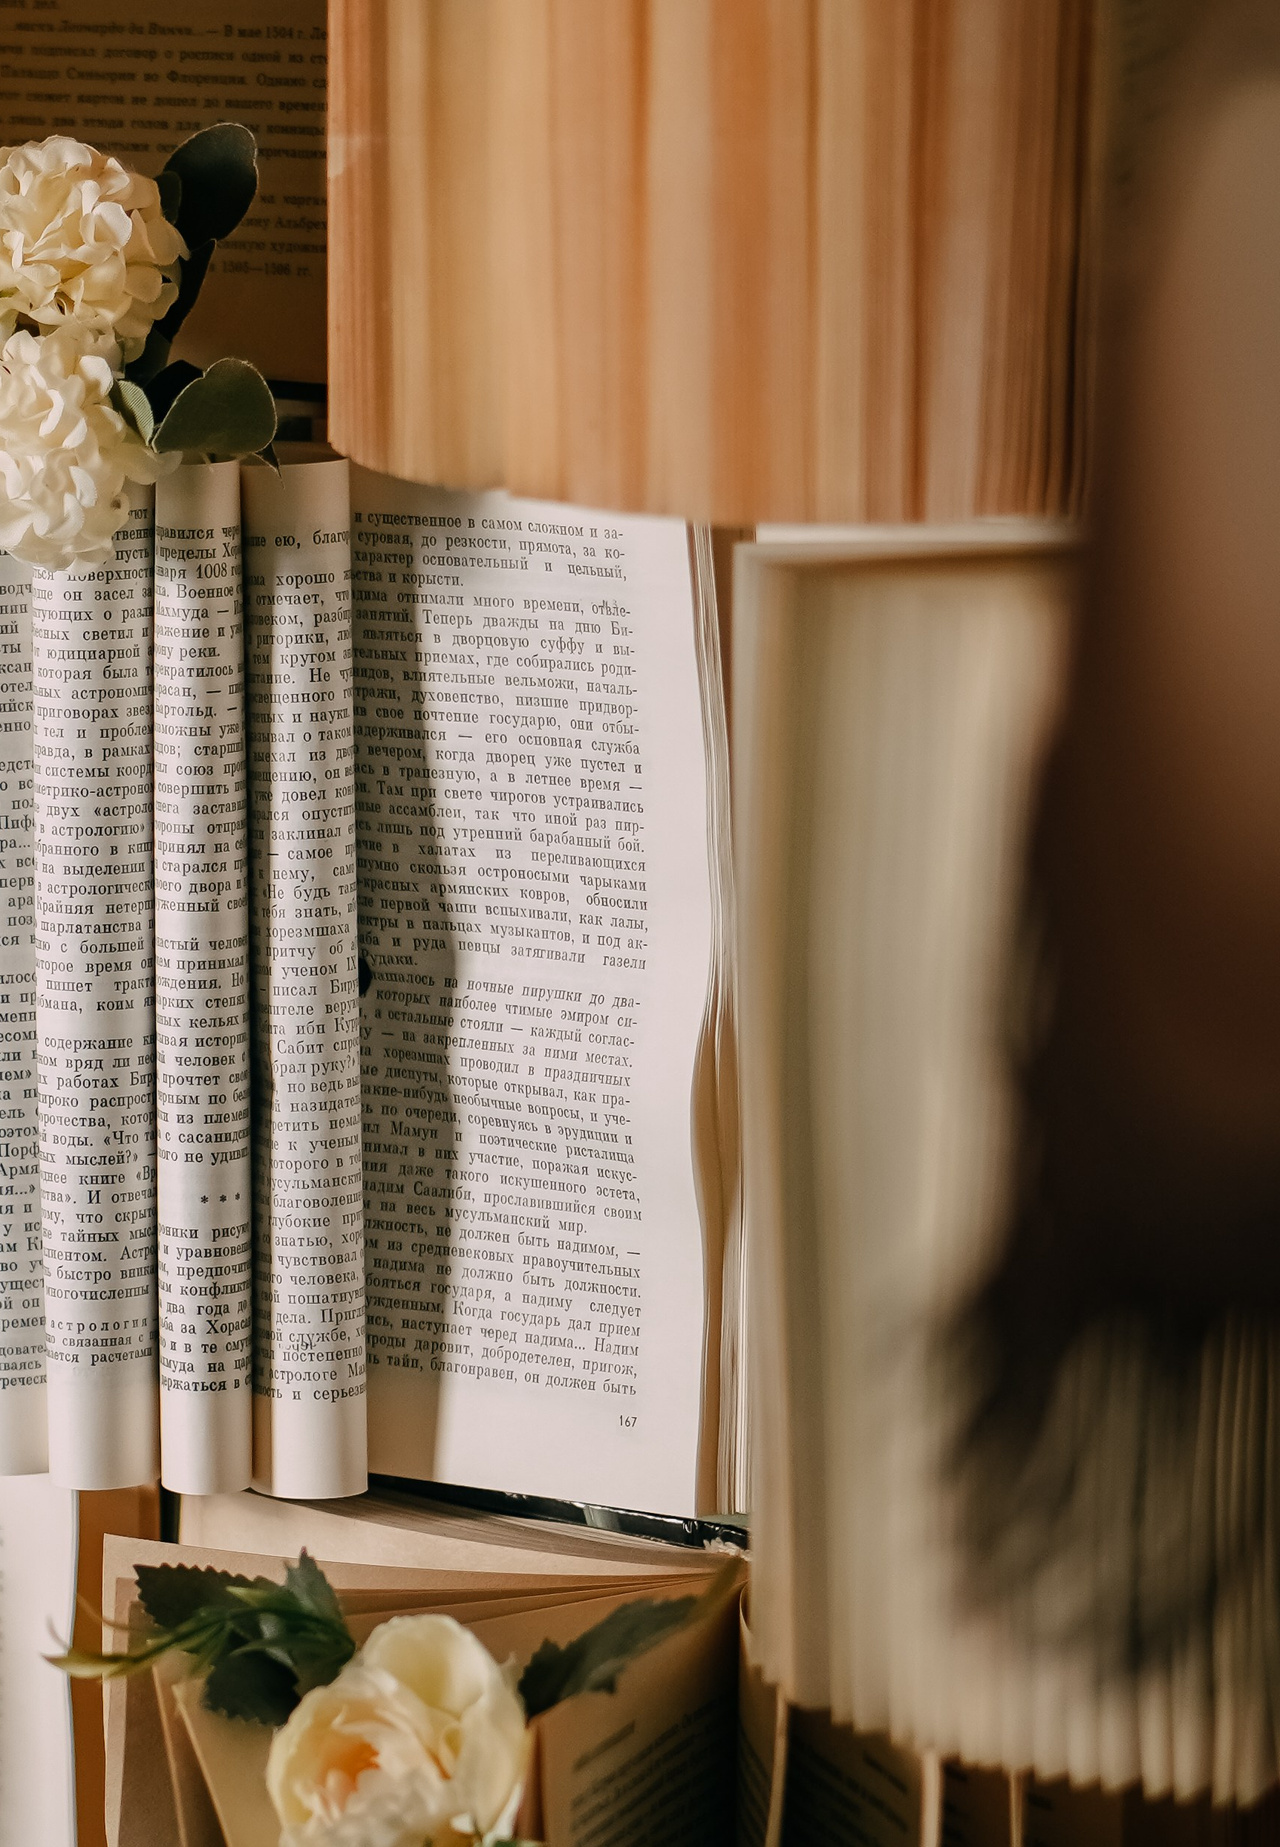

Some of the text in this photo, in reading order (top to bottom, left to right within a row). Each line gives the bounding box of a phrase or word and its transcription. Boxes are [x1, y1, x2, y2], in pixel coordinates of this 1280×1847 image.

[528, 522, 584, 537] сложном
[275, 535, 301, 550] ею,
[445, 536, 576, 558] резкости, прямота,
[195, 562, 228, 579] 1008
[422, 554, 627, 582] основательный цельный,
[276, 572, 335, 589] хорошо
[401, 573, 464, 588] корысти.
[94, 589, 134, 601] засел
[176, 583, 234, 599] Военное
[255, 593, 325, 607] отмечает,
[397, 592, 584, 616] отнимали много времени,
[422, 609, 539, 631] Теперь дважды
[82, 628, 134, 641] светил
[47, 644, 140, 664] юдициарной
[179, 647, 220, 661] реки.
[452, 635, 585, 655] дворцовую суффу
[280, 651, 336, 668] кругом
[516, 653, 595, 673] собирались
[402, 670, 578, 694] влиятельные вельможи,
[37, 706, 119, 723] приговорах
[579, 701, 638, 719] придвор-
[412, 709, 561, 730] почтение государю,
[102, 742, 152, 762] рамках
[518, 735, 640, 756] основная служба
[435, 750, 536, 767] когда дворец
[45, 766, 110, 778] системы
[176, 765, 214, 776] союз
[398, 766, 620, 793] трапезную, летнее время
[281, 789, 327, 804] довел
[490, 791, 644, 813] чирогов устраивались
[388, 801, 466, 821] ассамблеи,
[51, 823, 145, 840] астрологию»
[271, 827, 341, 841] заклинал
[452, 827, 611, 849] утренний барабанный
[287, 847, 333, 860] самое
[531, 851, 646, 872] переливающихся
[162, 861, 227, 877] старался
[188, 880, 232, 896] двора
[477, 867, 647, 892] остроносыми чарыками
[293, 885, 331, 902] будь
[430, 882, 648, 911] армянских ковров, обносили
[295, 906, 341, 919] знать,
[485, 905, 571, 925] вспыхивали,
[41, 921, 142, 937] шарлатанства
[490, 924, 574, 945] музыкантов,
[80, 936, 144, 954] большей
[176, 955, 244, 974] принимал
[458, 941, 646, 970] певцы затягивали газели
[84, 961, 132, 977] время
[281, 963, 338, 980] ученом
[273, 986, 317, 996] писал
[466, 980, 582, 1002] ночные пирушки
[439, 995, 609, 1027] наиболее чтимые эмиром
[189, 1015, 240, 1029] кельях
[387, 1009, 582, 1042] остальные стояли каждый
[44, 1037, 133, 1053] содержание
[277, 1039, 325, 1055] Сабит
[423, 1033, 632, 1068] закрепленных местах.
[174, 1054, 236, 1067] человек
[460, 1057, 631, 1087] проводил праздничных
[56, 1073, 119, 1090] работах
[445, 1074, 567, 1102] которые открывал,
[452, 1093, 584, 1123] необычные вопросы,
[468, 1114, 619, 1143] соревнуясь эрудиции
[65, 1149, 138, 1166] мыслей?»
[479, 1134, 635, 1165] поэтические ристалища
[468, 1152, 589, 1176] участие, поражая
[413, 1180, 596, 1215] Саалиби, прославившийся
[500, 1175, 640, 1204] искушенного эстета,
[444, 1207, 550, 1229] мусульманский
[60, 1229, 120, 1243] тайных
[275, 1236, 333, 1249] знатью,
[459, 1229, 618, 1259] должен надимом,
[277, 1251, 357, 1269] чувствовал
[411, 1242, 641, 1278] средневековых нравоучительных
[57, 1265, 112, 1285] быстро
[290, 1270, 359, 1286] человека,
[461, 1267, 641, 1298] должно должности.
[430, 1282, 641, 1319] государя, надиму следует
[196, 1304, 231, 1318] года
[452, 1300, 640, 1337] Когда государь прием
[50, 1318, 147, 1335] астрология
[289, 1327, 350, 1343] службе,
[62, 1336, 132, 1347] связанная
[594, 1337, 639, 1356] Надим
[90, 1347, 154, 1367] расчетами
[283, 1344, 363, 1362] постепенно
[481, 1345, 637, 1379] добродетелен, пригож,
[430, 1356, 596, 1391] благонравен, должен
[619, 1415, 637, 1428] 167
